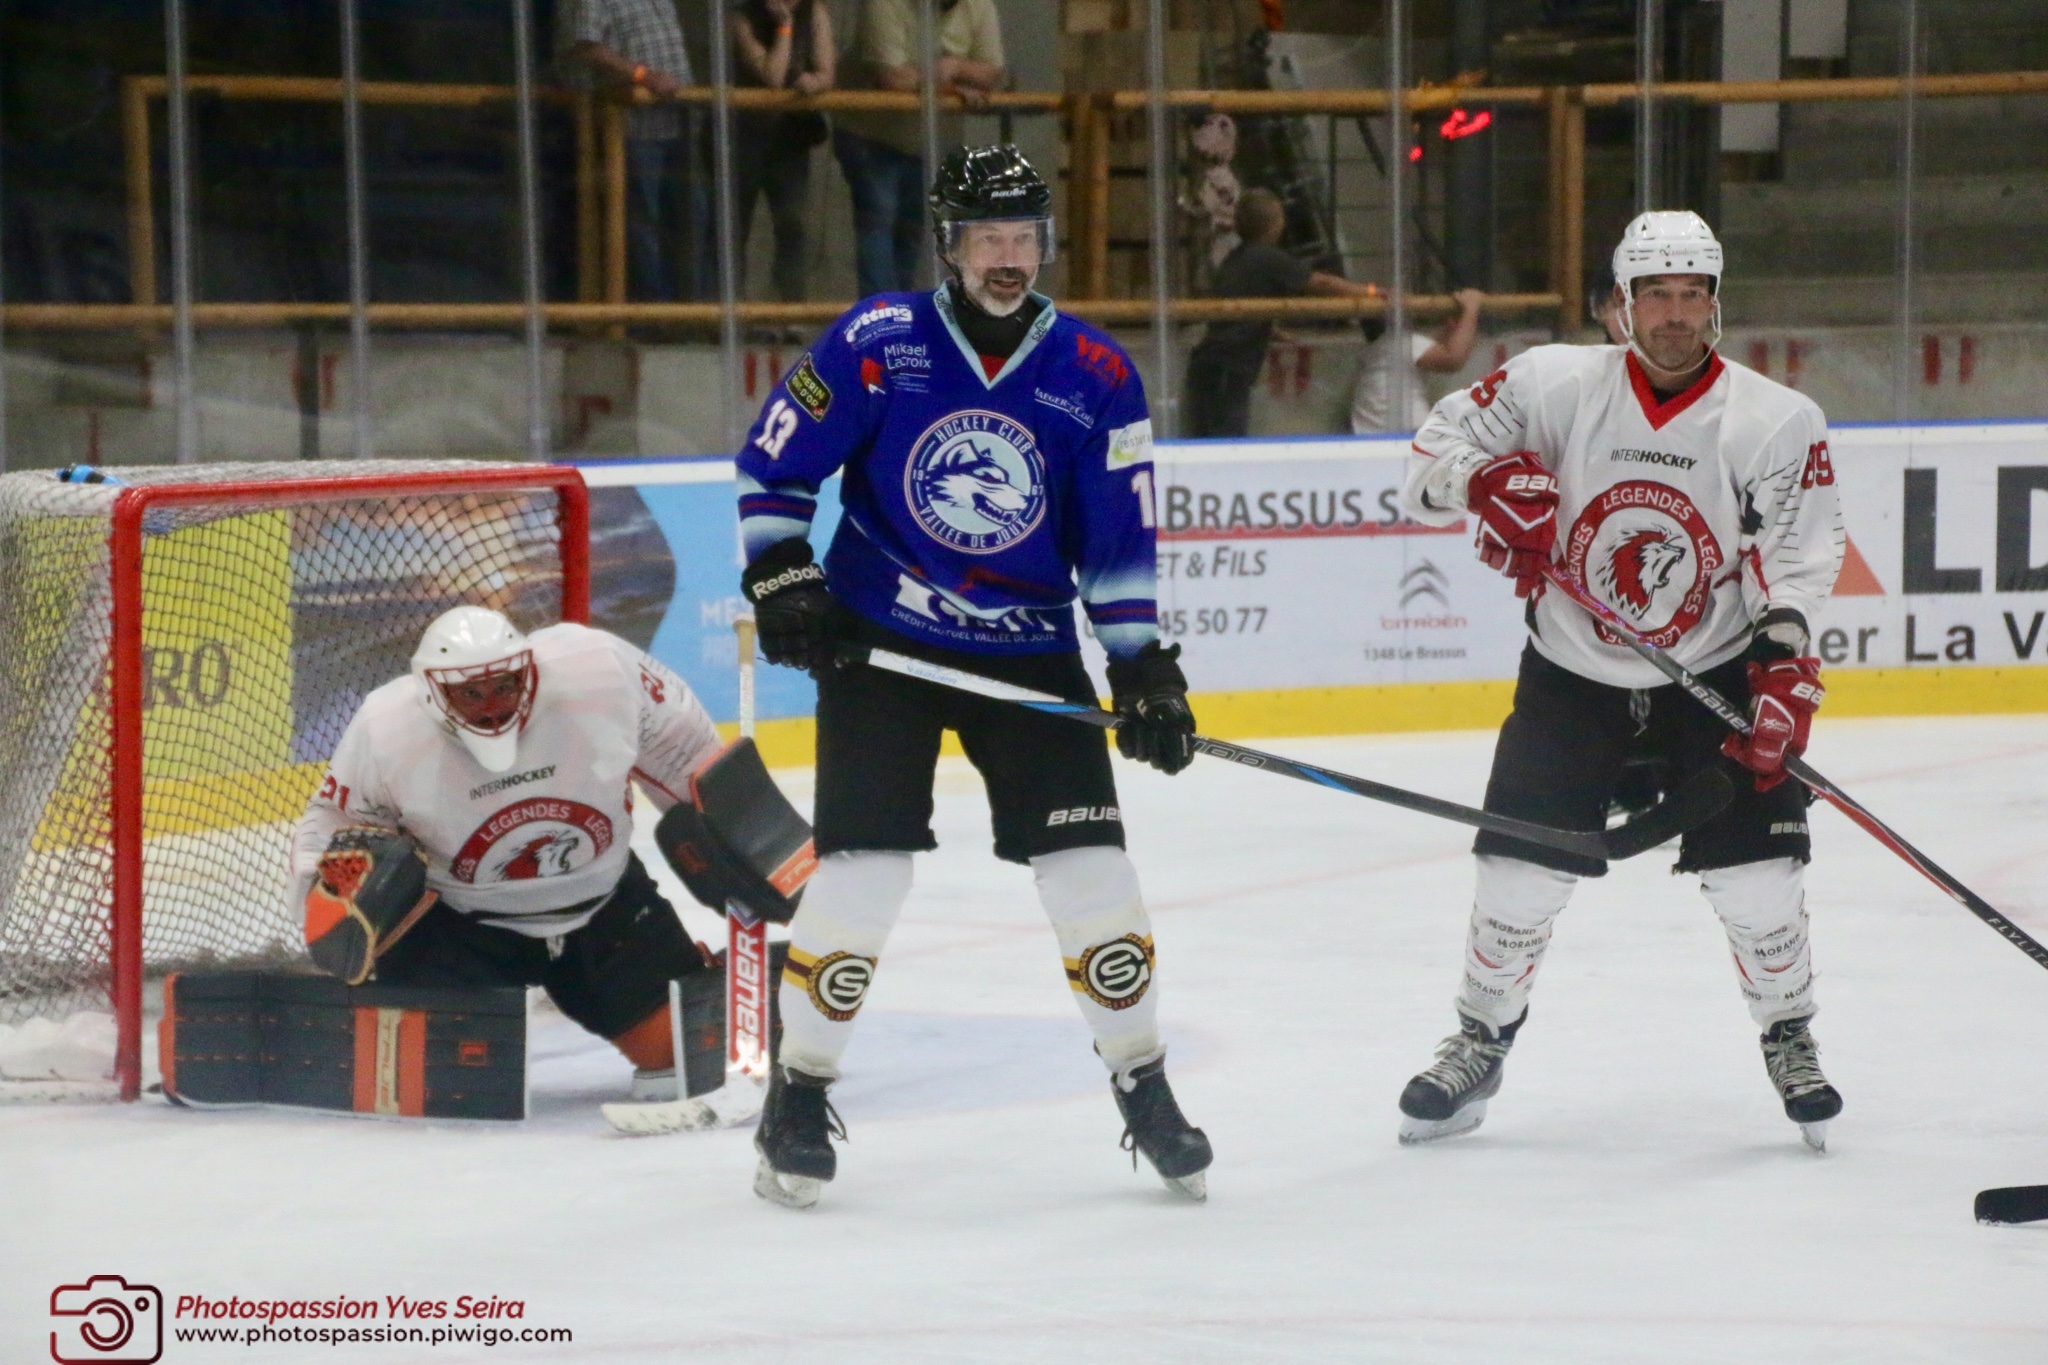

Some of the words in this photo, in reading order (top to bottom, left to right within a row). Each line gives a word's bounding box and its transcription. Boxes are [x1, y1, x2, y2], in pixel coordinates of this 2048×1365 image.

[884, 344, 926, 357] Mikael
[886, 356, 932, 370] Lacroix
[754, 398, 799, 460] 13
[934, 416, 990, 443] HOCKEY
[998, 422, 1032, 454] CLUB
[1610, 449, 1697, 470] INTERHOCKEY
[1602, 487, 1694, 521] LEGENDES
[970, 534, 986, 548] DE
[995, 518, 1029, 546] JOUX
[1186, 551, 1205, 579] &
[1211, 545, 1268, 577] FILS
[752, 564, 824, 600] Reebok
[1196, 607, 1228, 635] 50
[1236, 605, 1268, 634] 77
[1905, 613, 1976, 662] La
[2003, 611, 2048, 661] V
[469, 765, 556, 800] INTERHOCKEY
[479, 803, 572, 842] LEGENDES
[1496, 937, 1544, 949] MORAND
